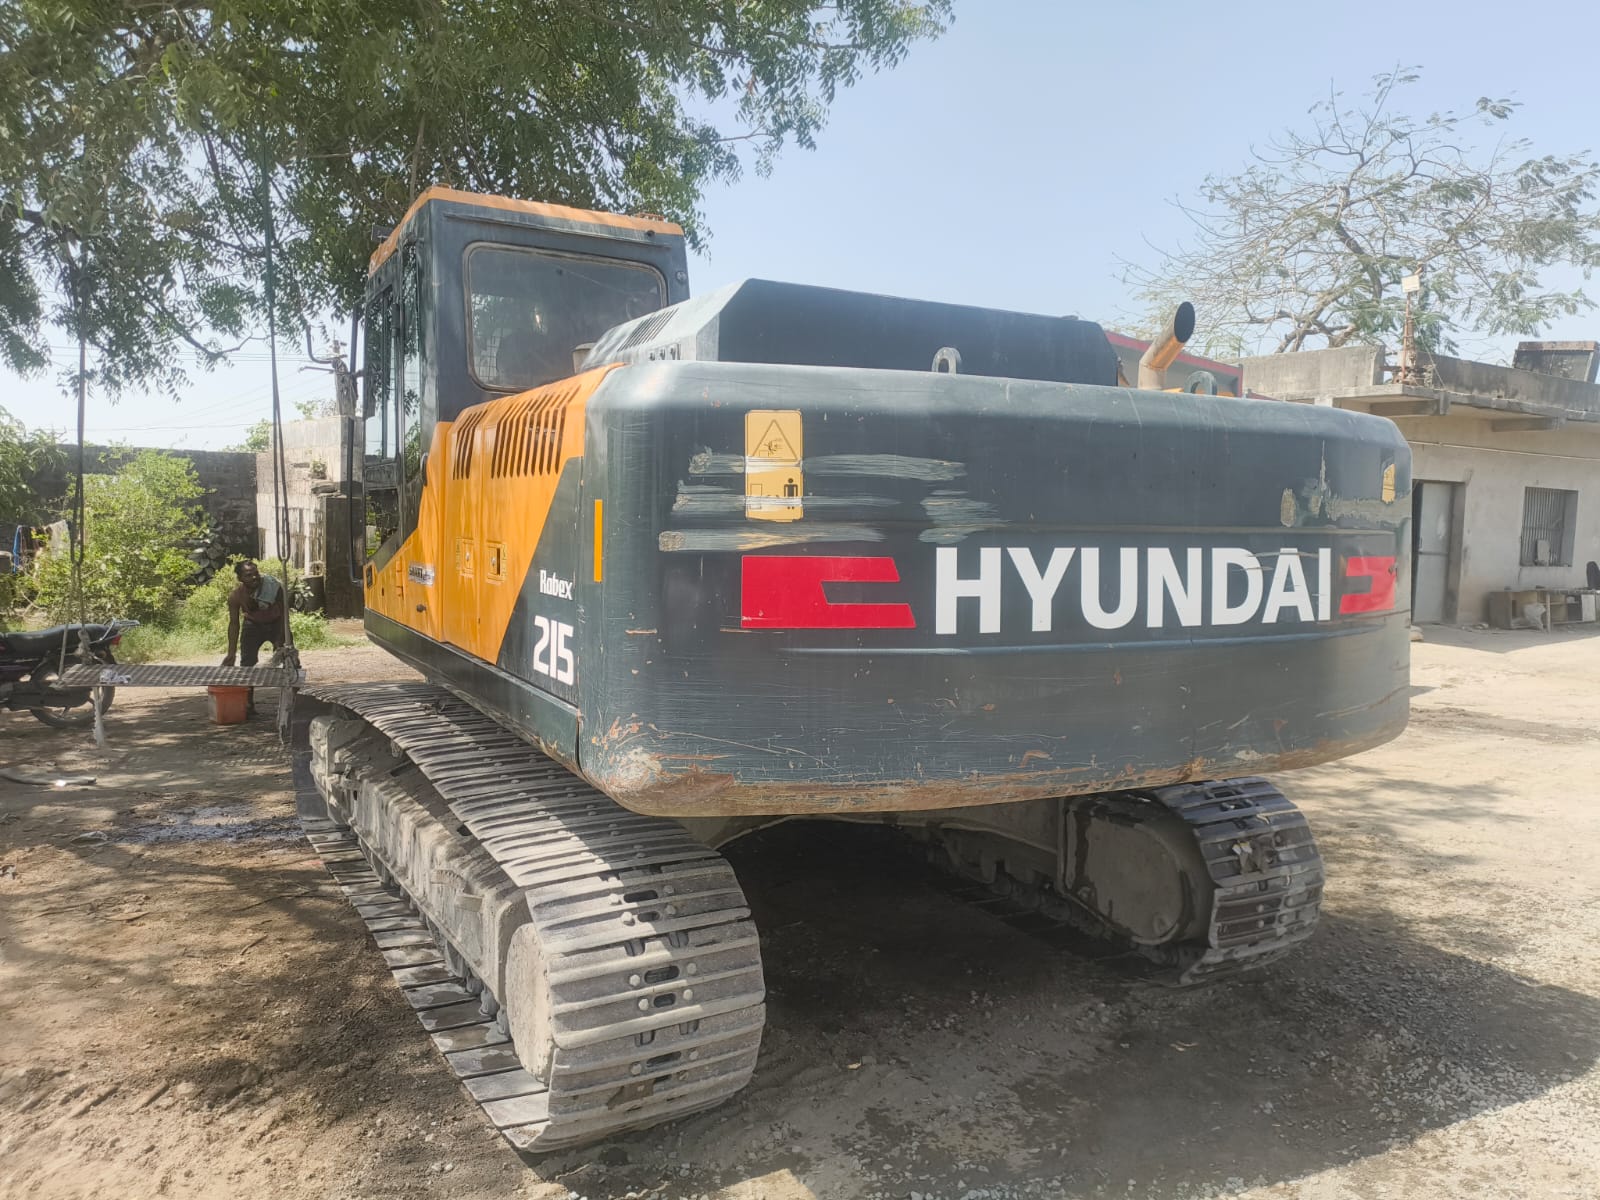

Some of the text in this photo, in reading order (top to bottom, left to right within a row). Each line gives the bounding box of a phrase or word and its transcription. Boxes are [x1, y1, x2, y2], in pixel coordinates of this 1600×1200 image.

[539, 569, 573, 601] Robex
[935, 547, 1332, 635] HYUNDAI
[533, 615, 575, 686] 215
